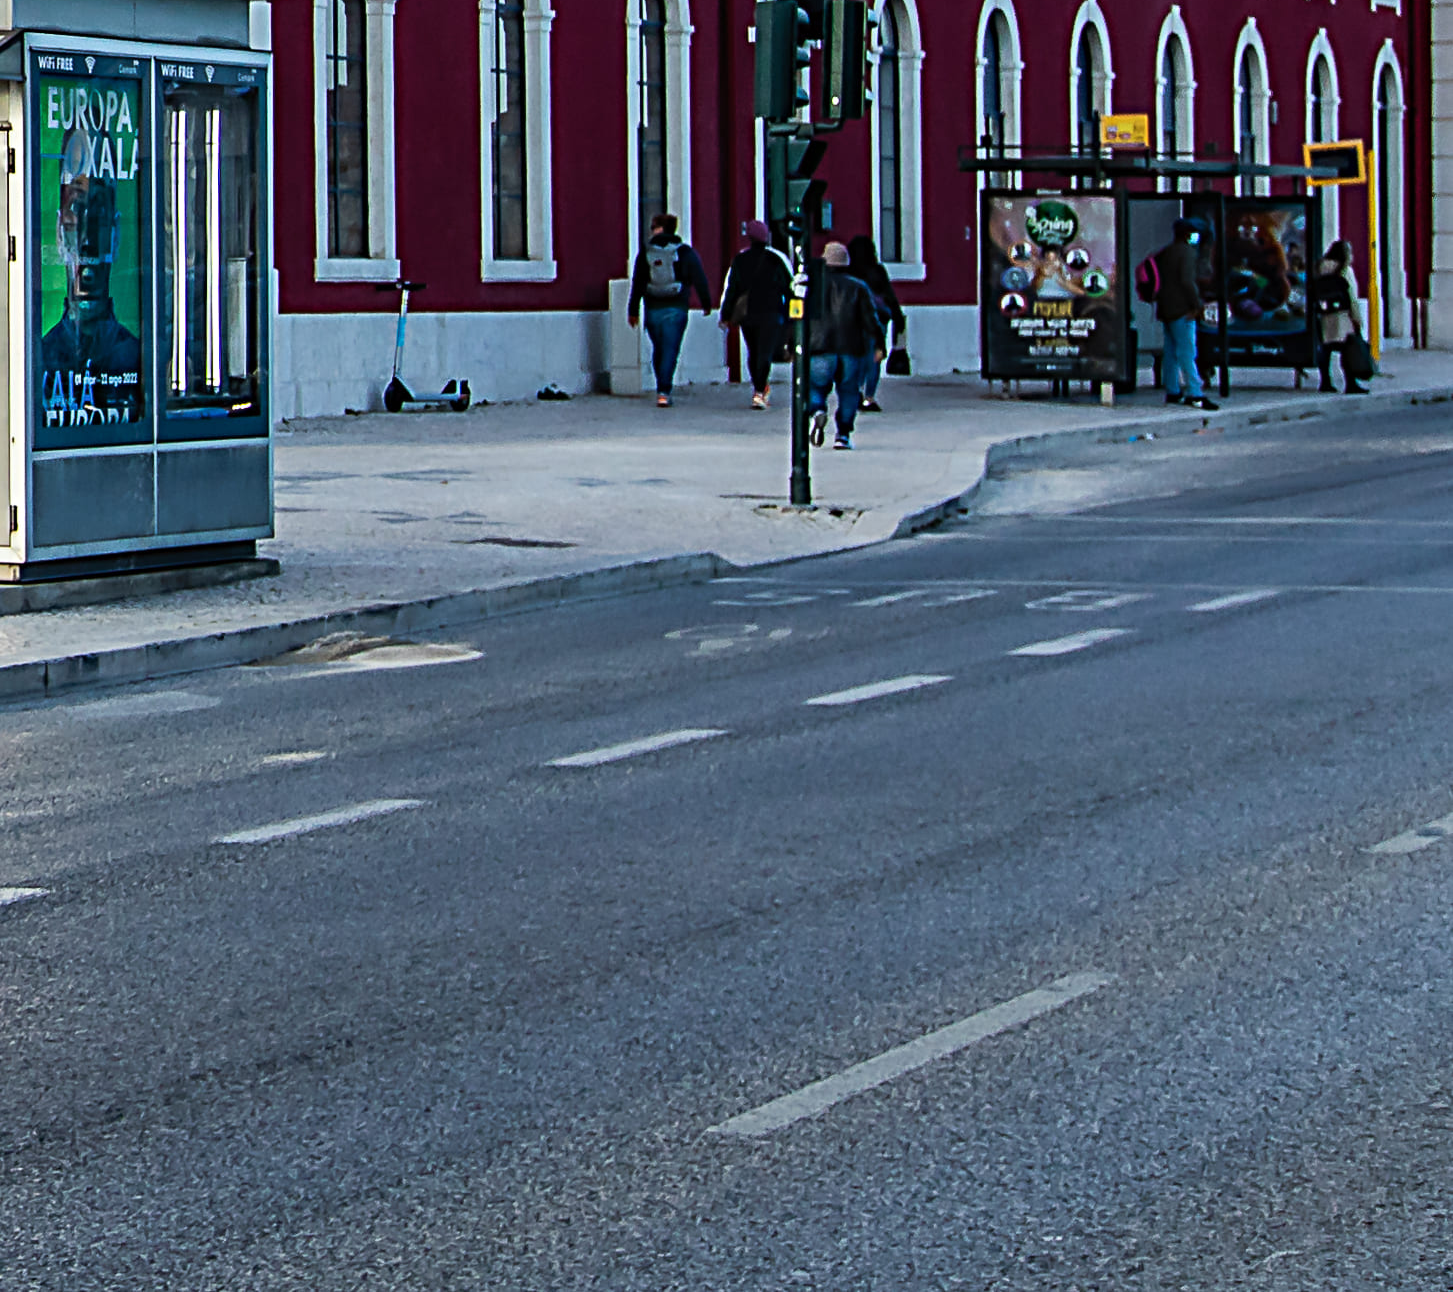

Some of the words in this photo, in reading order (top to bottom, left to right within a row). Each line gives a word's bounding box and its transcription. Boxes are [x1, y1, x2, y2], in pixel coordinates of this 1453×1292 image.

[56, 57, 73, 71] FREE
[178, 65, 194, 79] FREE
[48, 86, 133, 133] EUROPA
